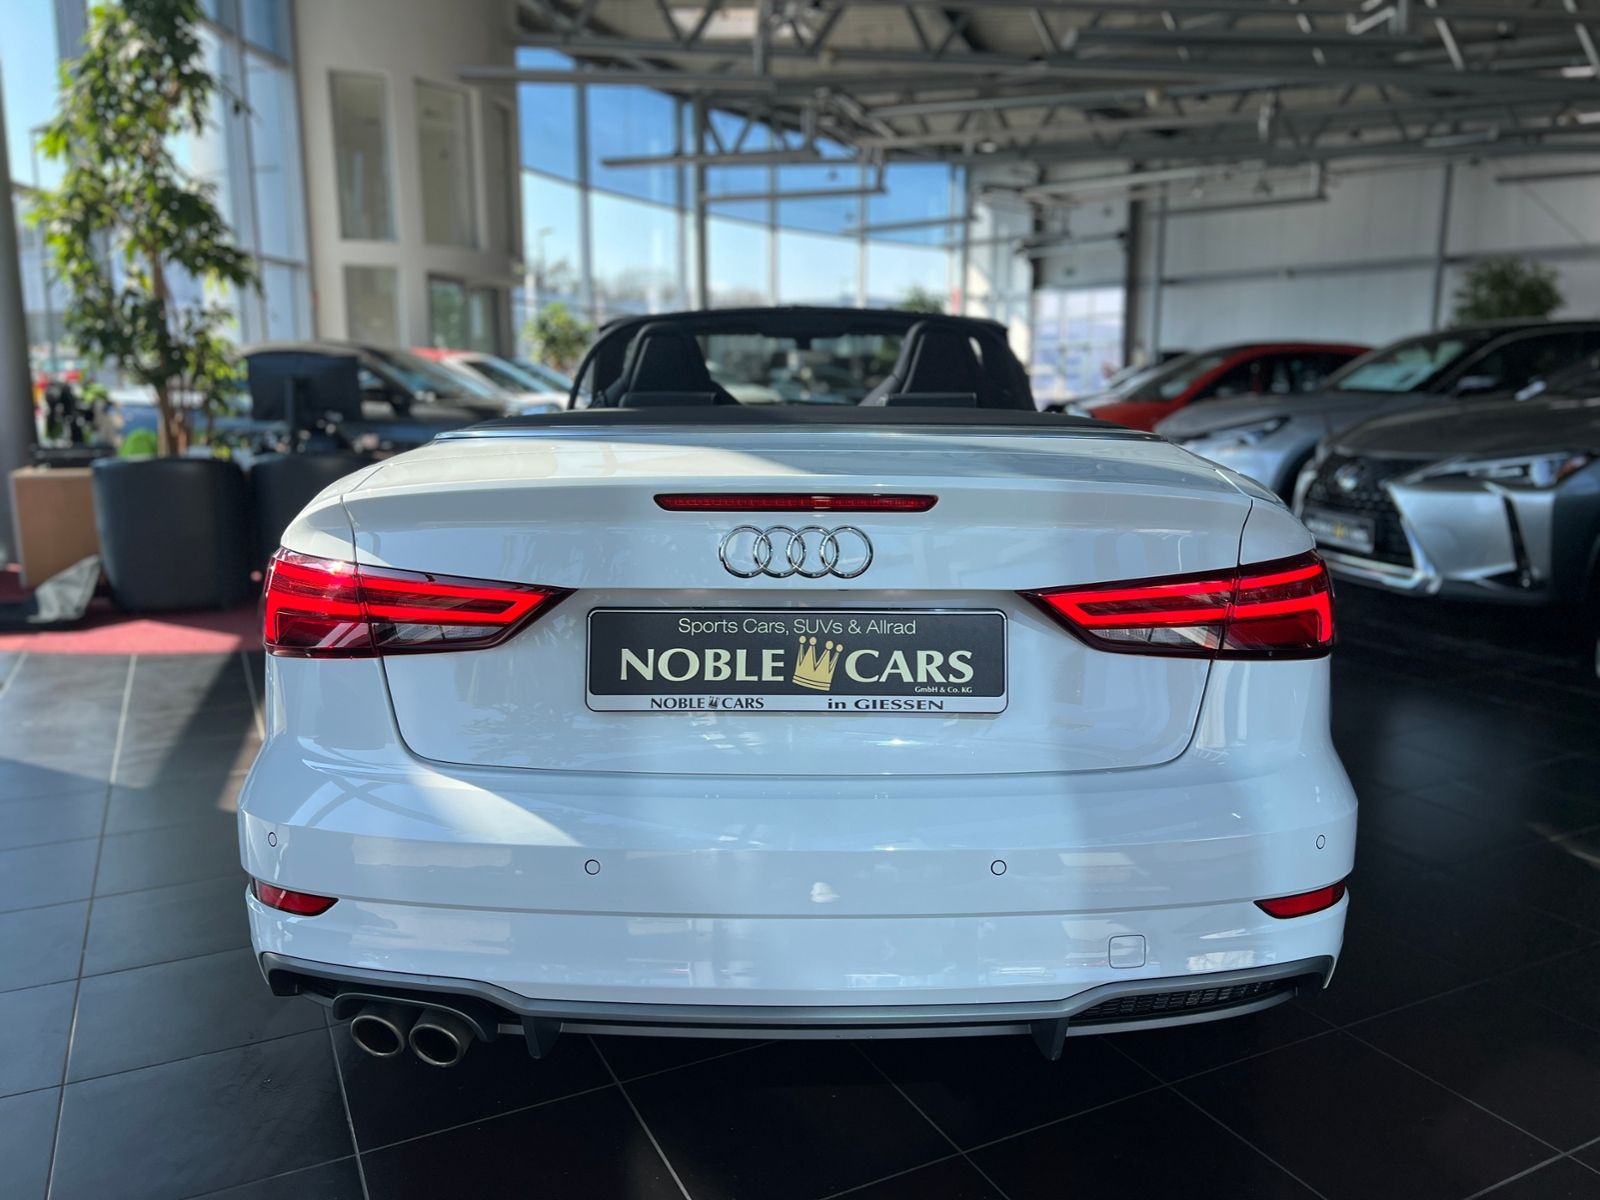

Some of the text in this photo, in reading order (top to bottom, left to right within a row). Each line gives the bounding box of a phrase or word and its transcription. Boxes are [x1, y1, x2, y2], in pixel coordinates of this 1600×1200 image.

[678, 618, 917, 636] Sports Cars, SUVs & Allrad
[620, 648, 975, 683] NOBLE CARS
[914, 686, 973, 694] GmbH & Co. KG
[650, 697, 765, 710] NOBLE CARS
[827, 697, 944, 711] in GIESSEN
